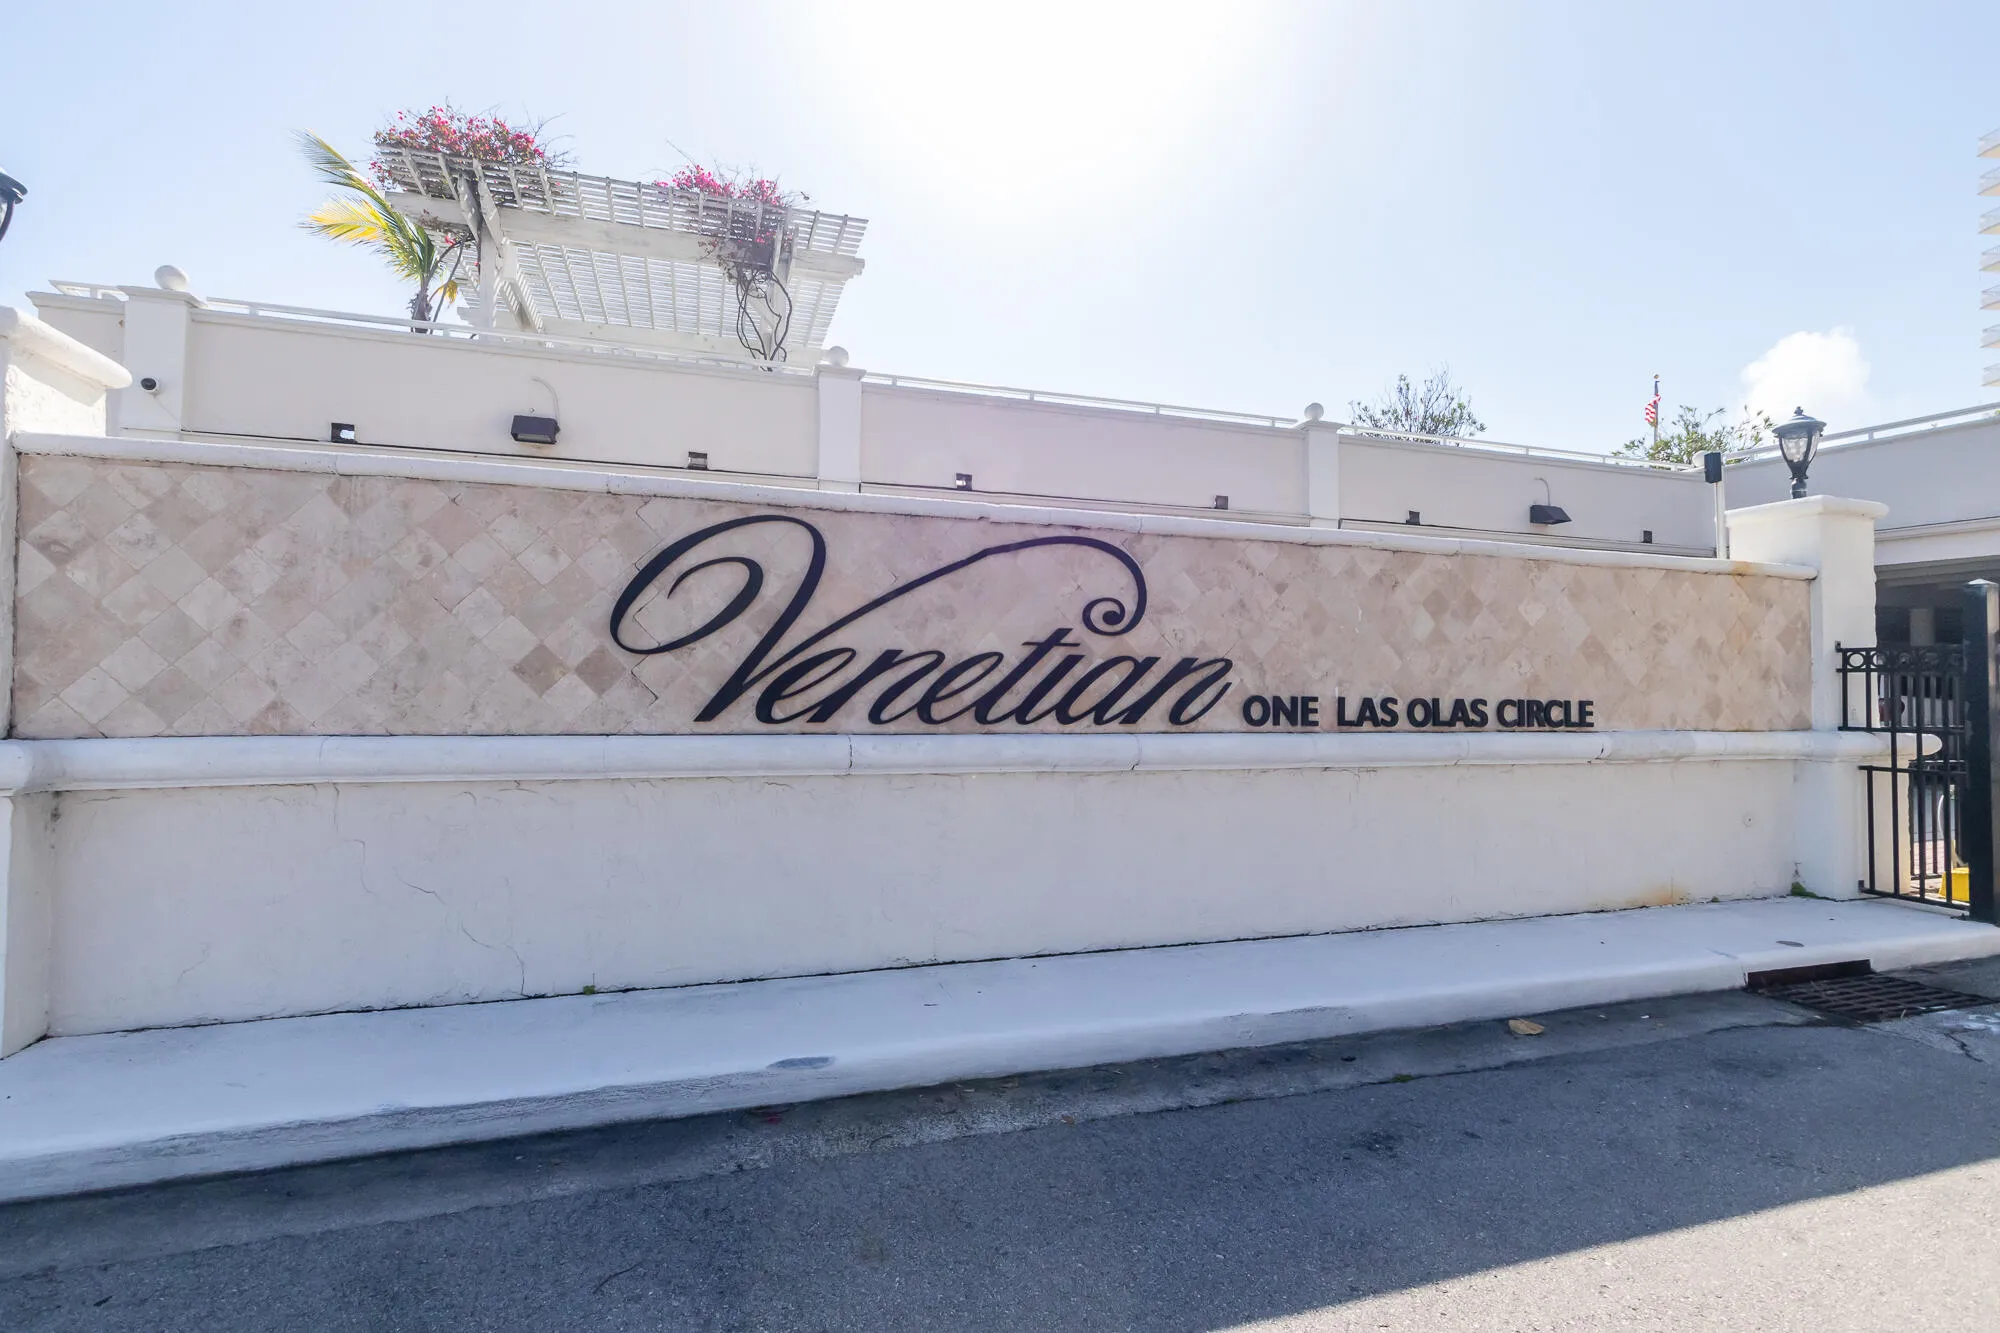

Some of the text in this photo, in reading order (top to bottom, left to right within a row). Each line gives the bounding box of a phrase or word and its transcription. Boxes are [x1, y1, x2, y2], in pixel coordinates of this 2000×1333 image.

[609, 514, 1233, 726] Venetian
[1242, 695, 1595, 729] ONE LAS OLAS CIRCLE
